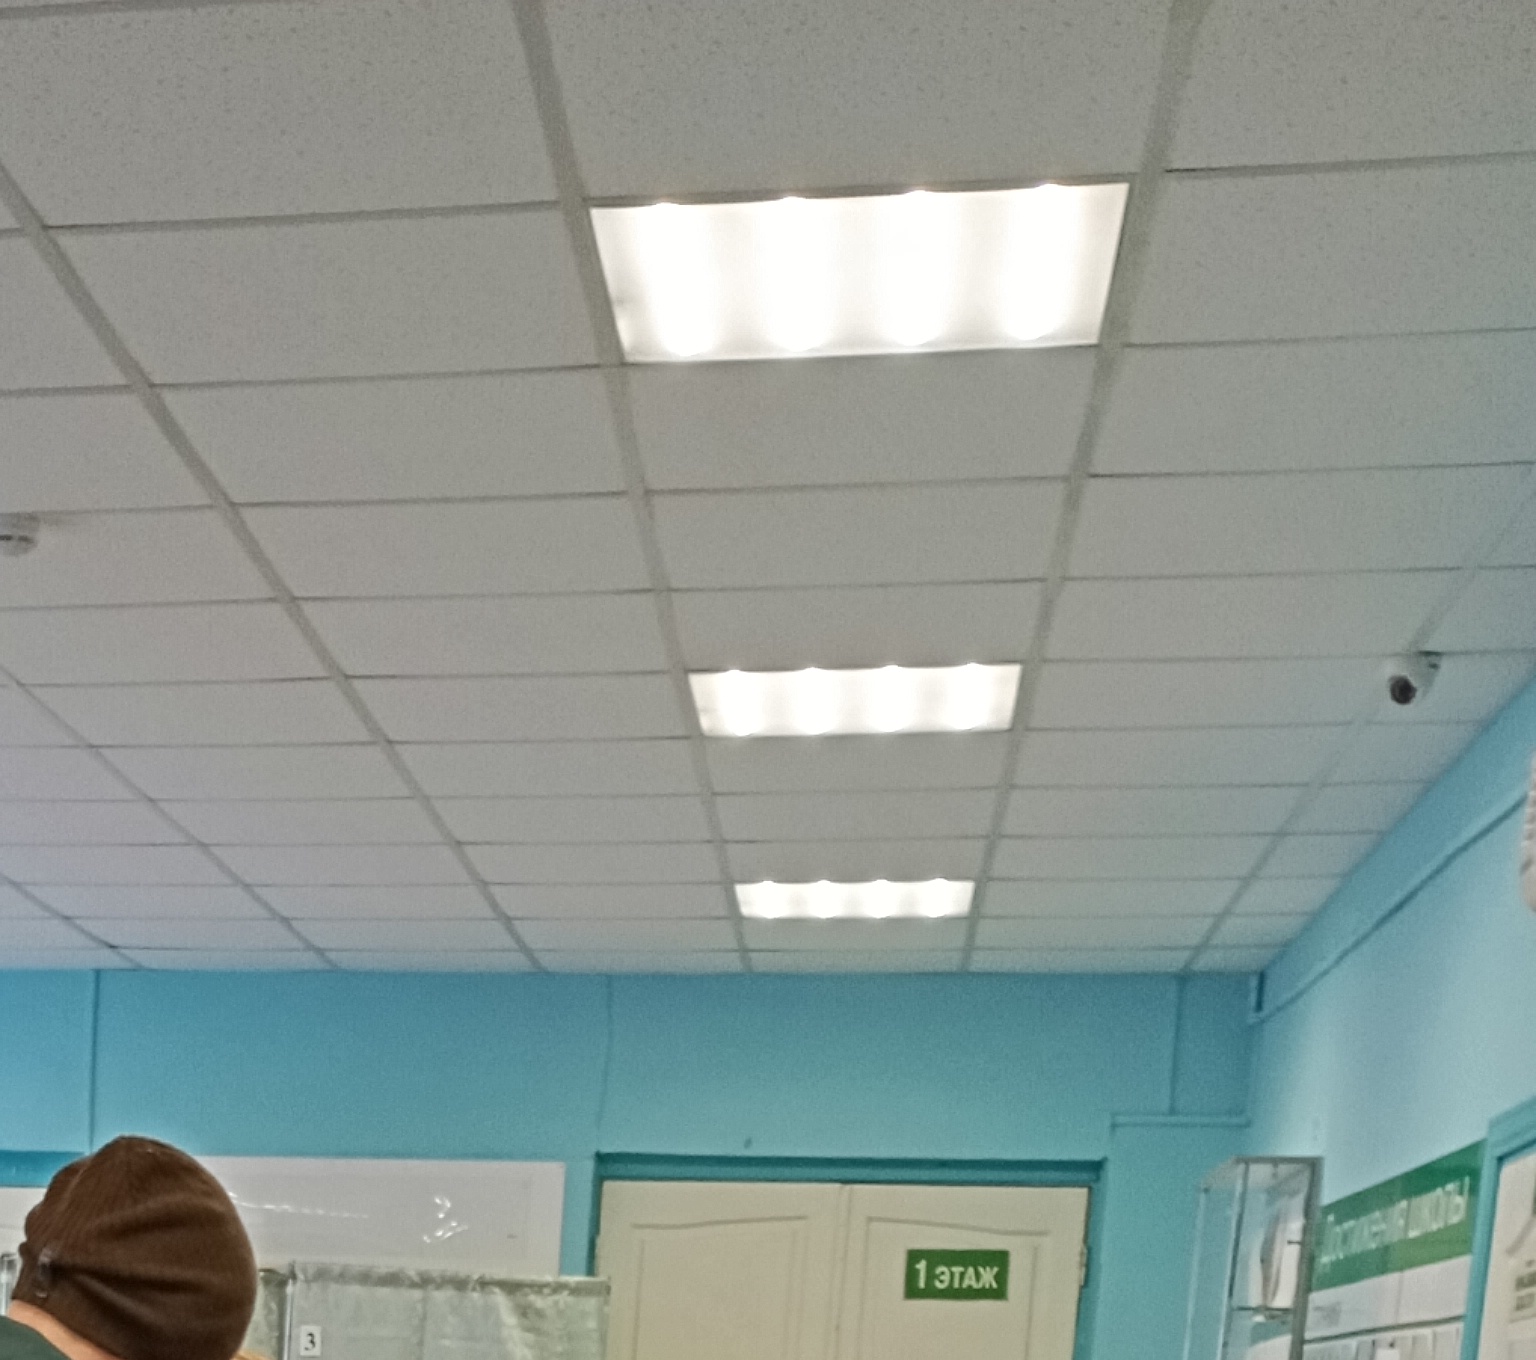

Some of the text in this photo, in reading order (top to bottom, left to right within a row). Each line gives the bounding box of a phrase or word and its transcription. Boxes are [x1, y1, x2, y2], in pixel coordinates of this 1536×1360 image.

[914, 1259, 999, 1289] 1 ЭТАЖ
[304, 1331, 316, 1352] 3
